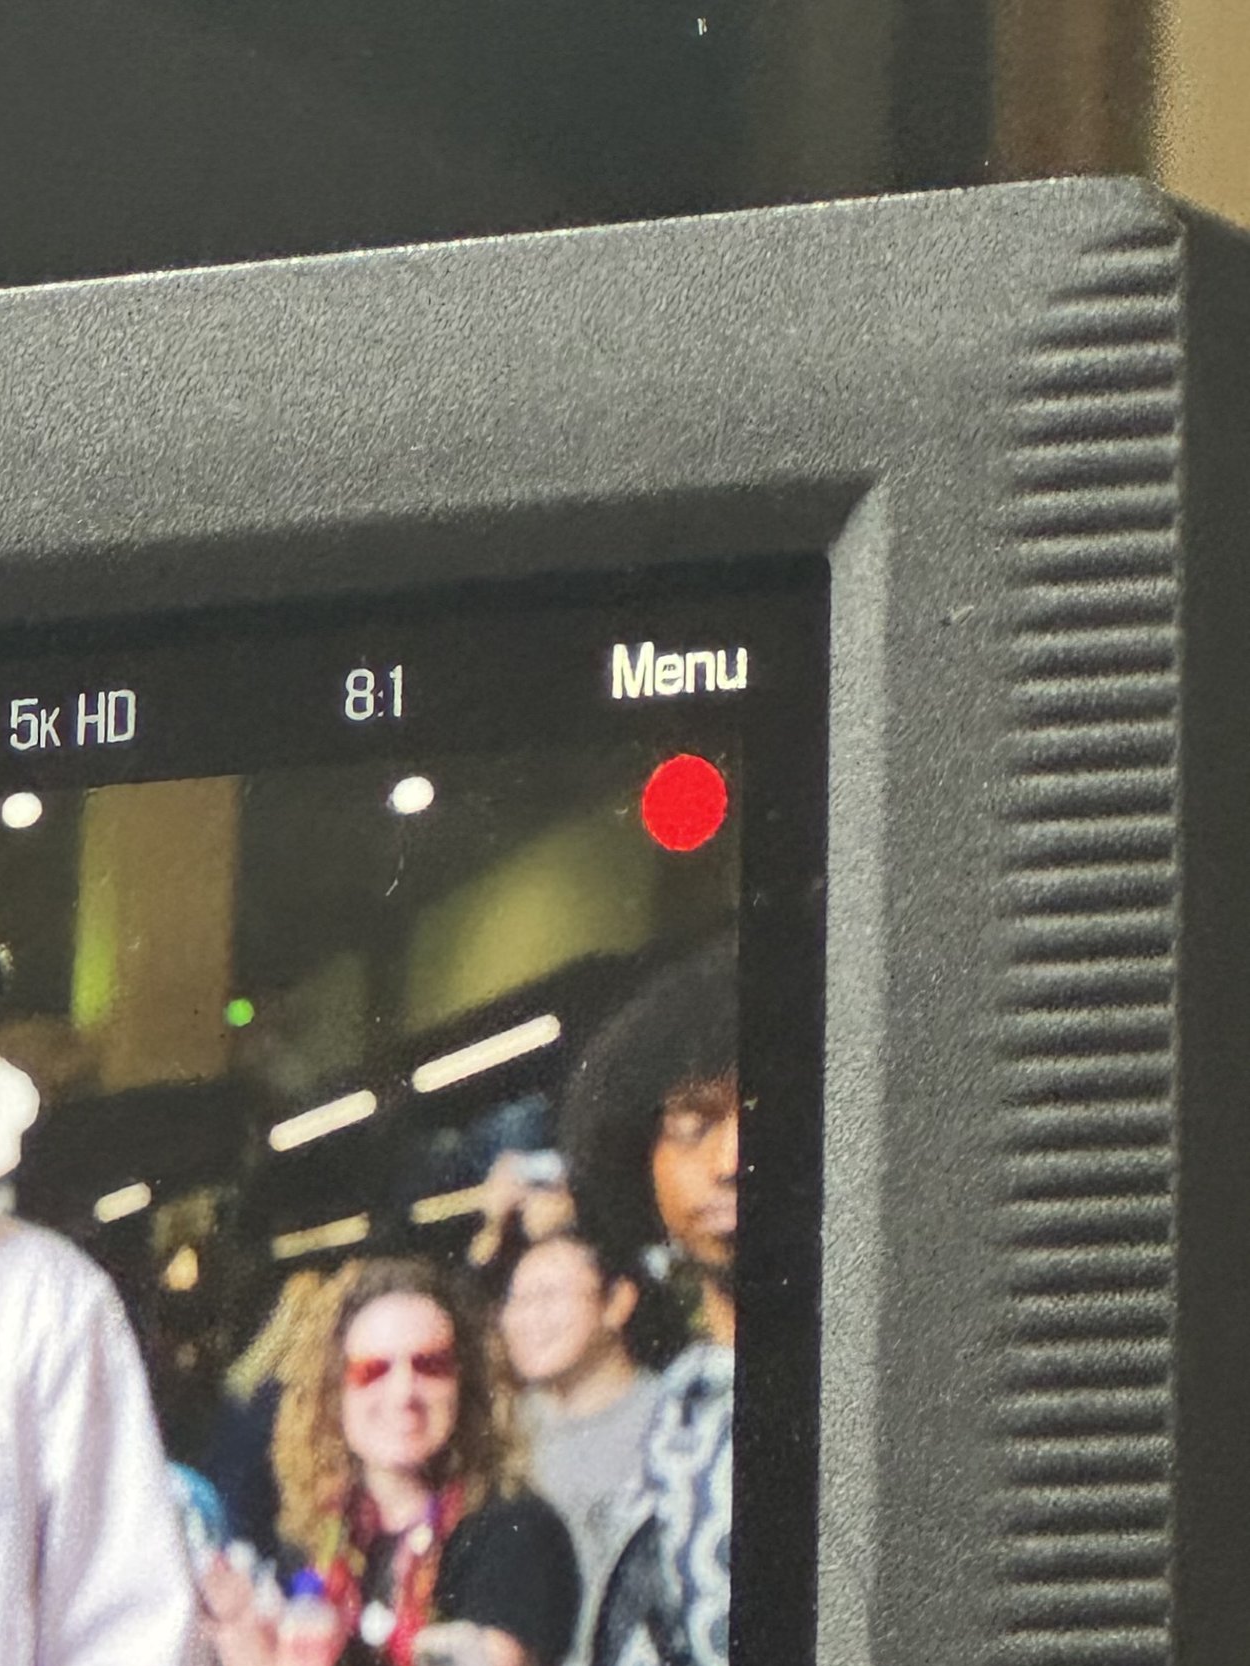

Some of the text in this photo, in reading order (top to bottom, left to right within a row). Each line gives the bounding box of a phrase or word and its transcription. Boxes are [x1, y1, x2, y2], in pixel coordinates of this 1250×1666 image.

[344, 665, 403, 720] 8:1
[611, 642, 748, 700] Menu
[76, 689, 137, 745] HD
